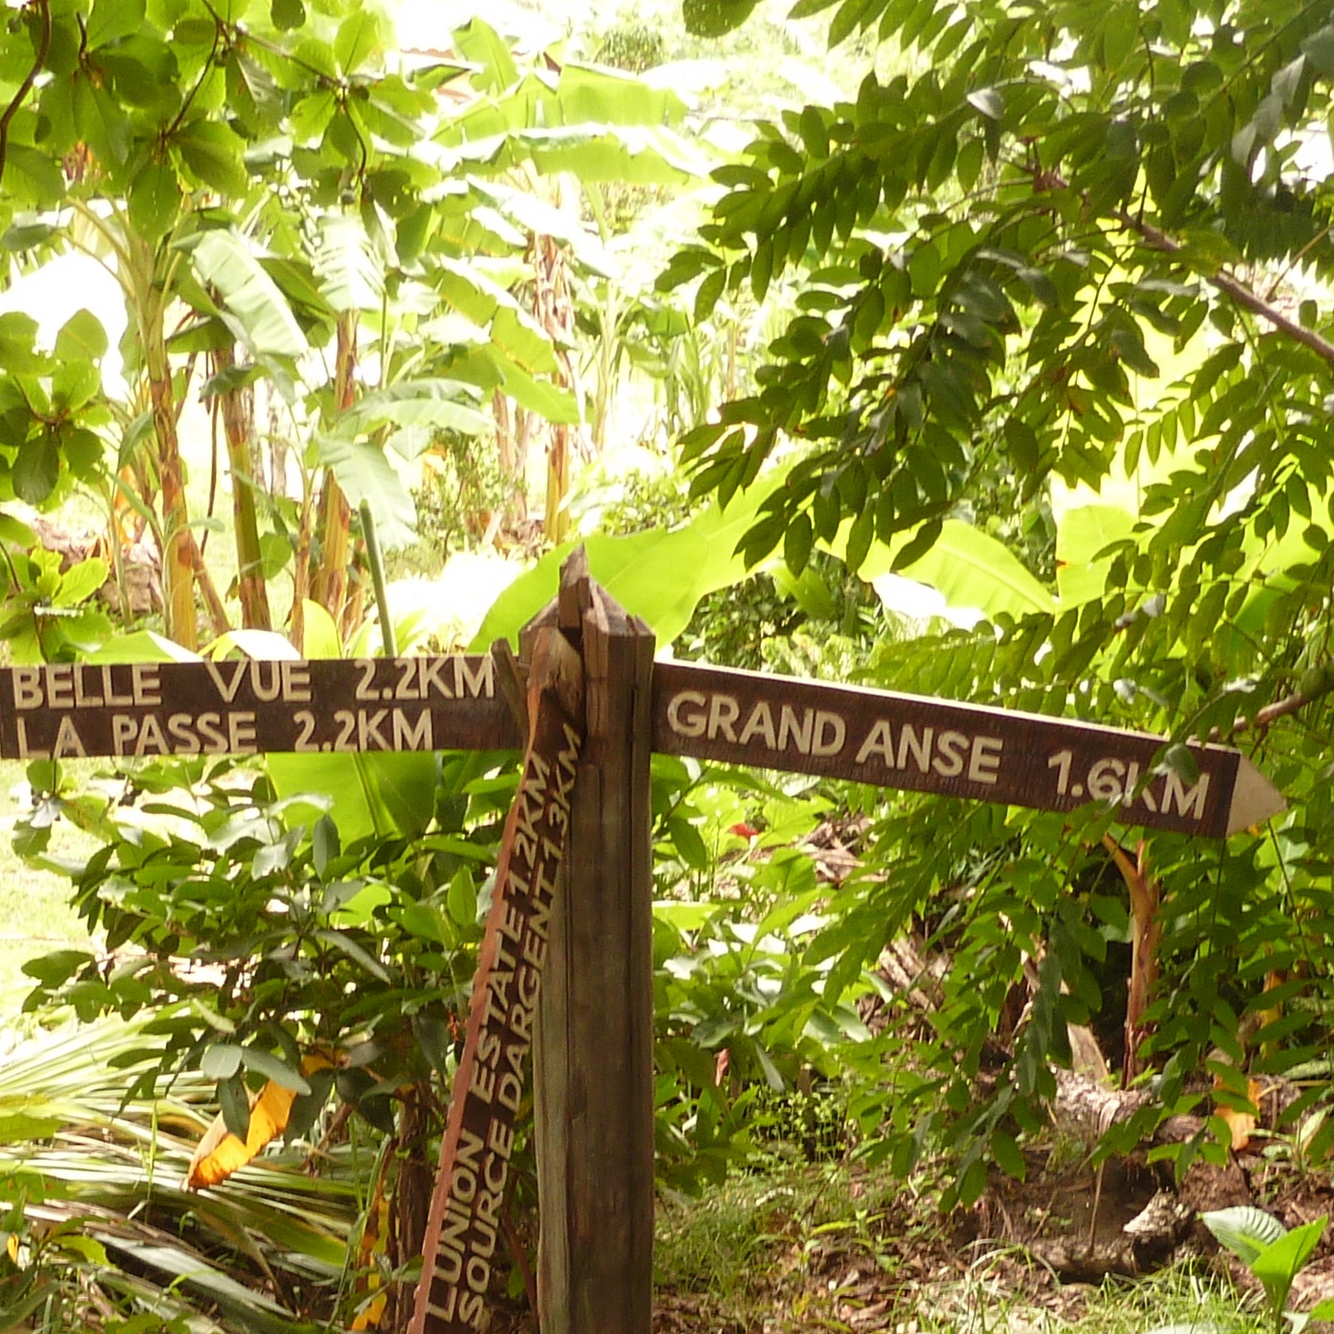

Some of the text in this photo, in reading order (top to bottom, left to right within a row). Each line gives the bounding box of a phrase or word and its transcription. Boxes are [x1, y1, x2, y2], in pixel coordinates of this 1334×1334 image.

[12, 656, 495, 709] BELLE VUE 2.2KM
[15, 706, 434, 759] LA PASSE 2.2KM
[667, 690, 1211, 821] GRAND ANSE 1.6KM
[470, 900, 524, 1104] ESTATE
[458, 1117, 515, 1329] SOURCE
